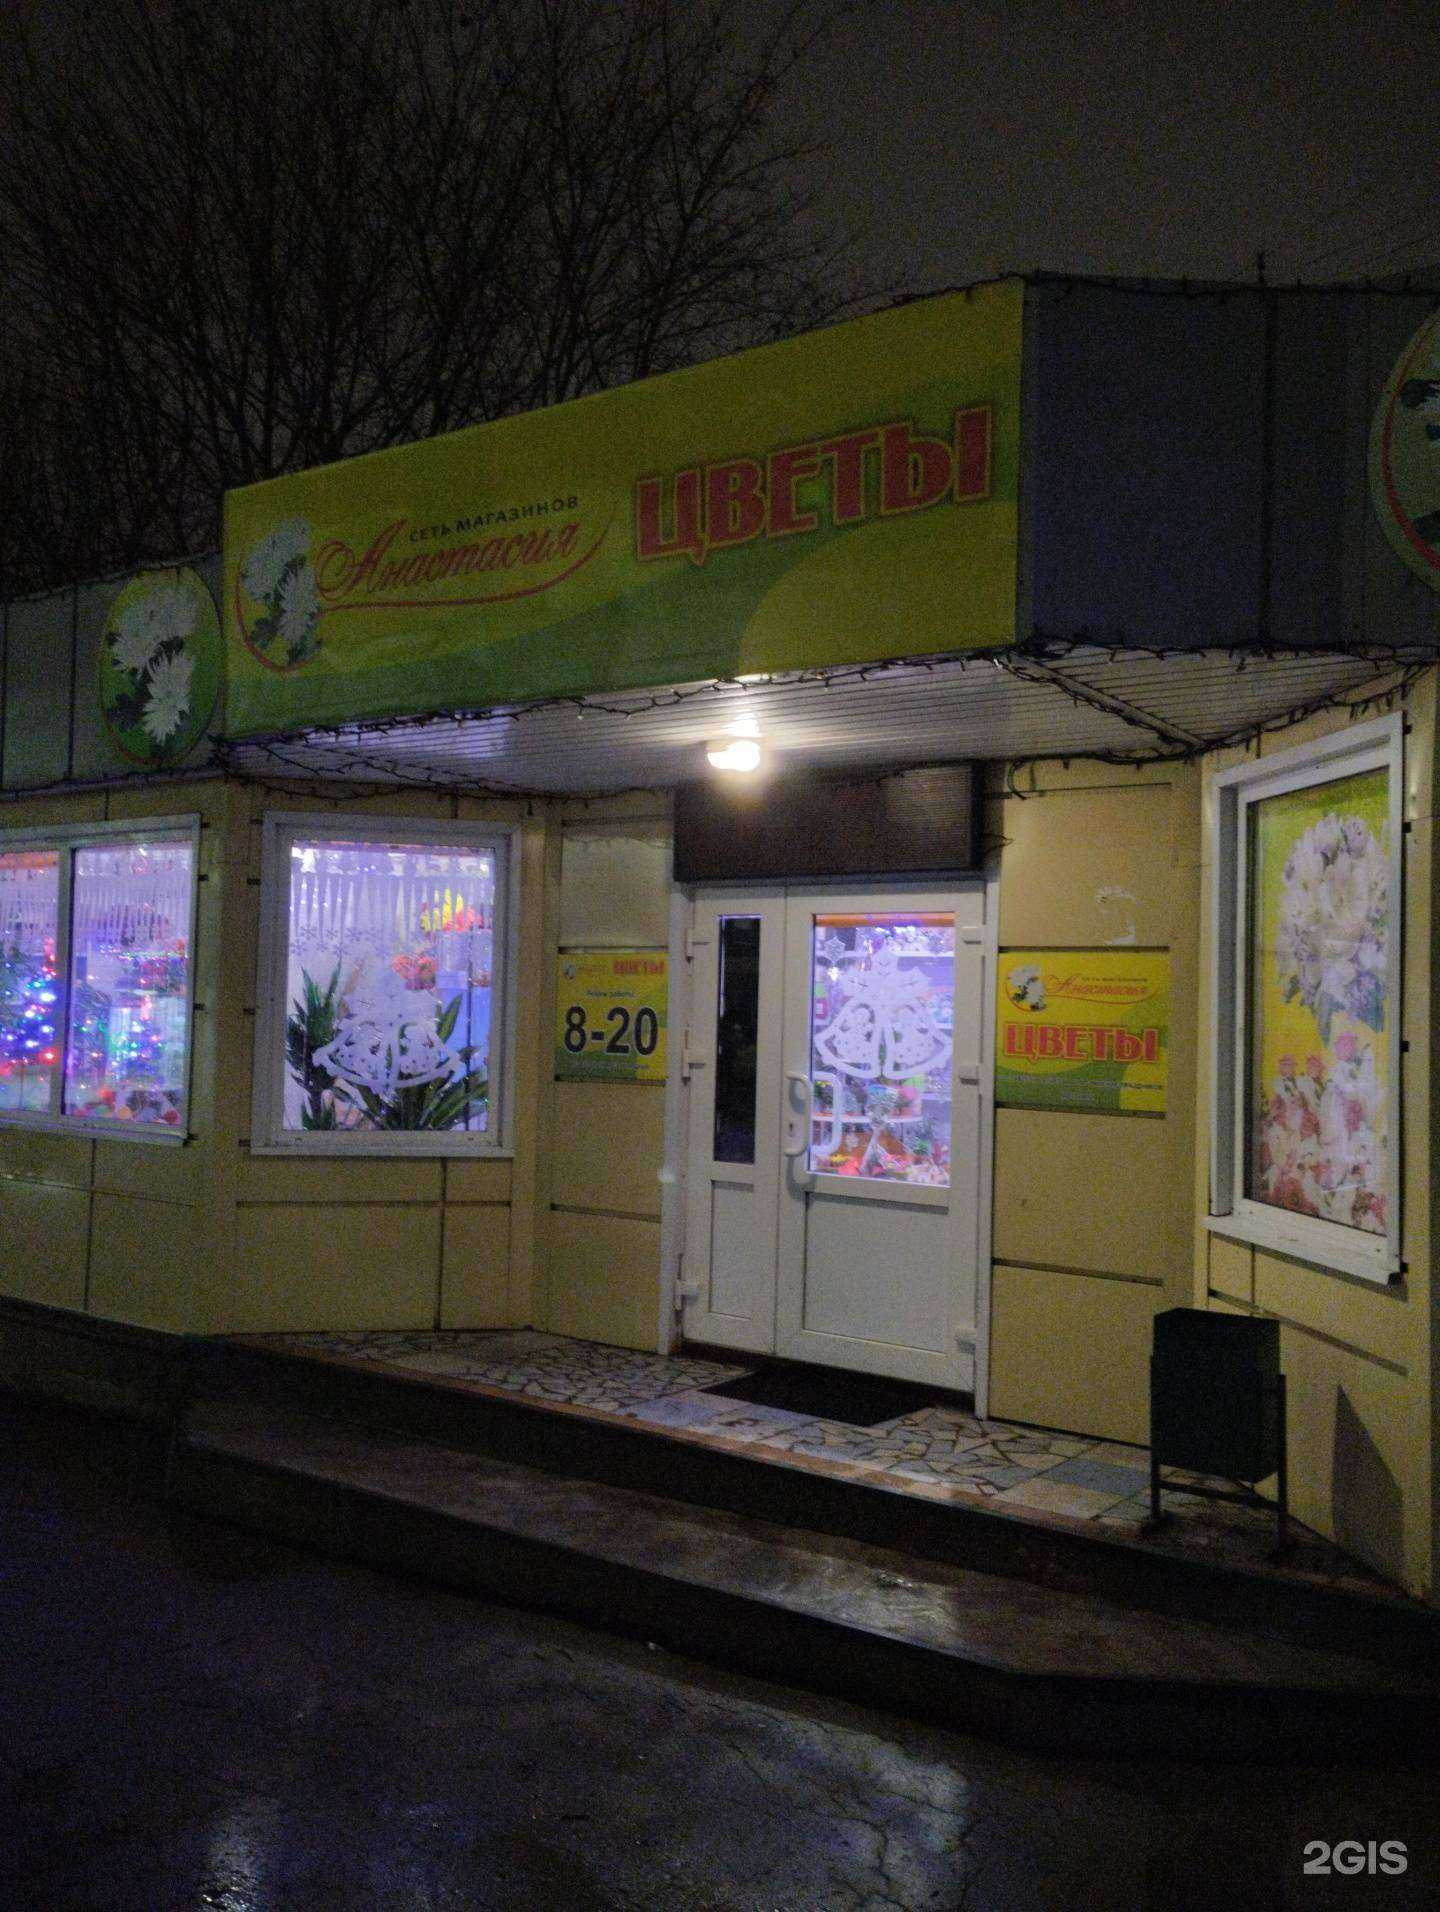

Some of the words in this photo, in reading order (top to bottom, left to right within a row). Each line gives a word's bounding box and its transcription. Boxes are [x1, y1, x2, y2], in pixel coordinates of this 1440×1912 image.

[636, 405, 992, 567] ЦВЕТЫ
[409, 526, 451, 543] СЕТЬ
[455, 495, 579, 534] МАГАЗИНОВ
[315, 518, 581, 600] Анастасия
[564, 1006, 658, 1055] 8-20
[1003, 1022, 1159, 1064] ЦВЕТЫ
